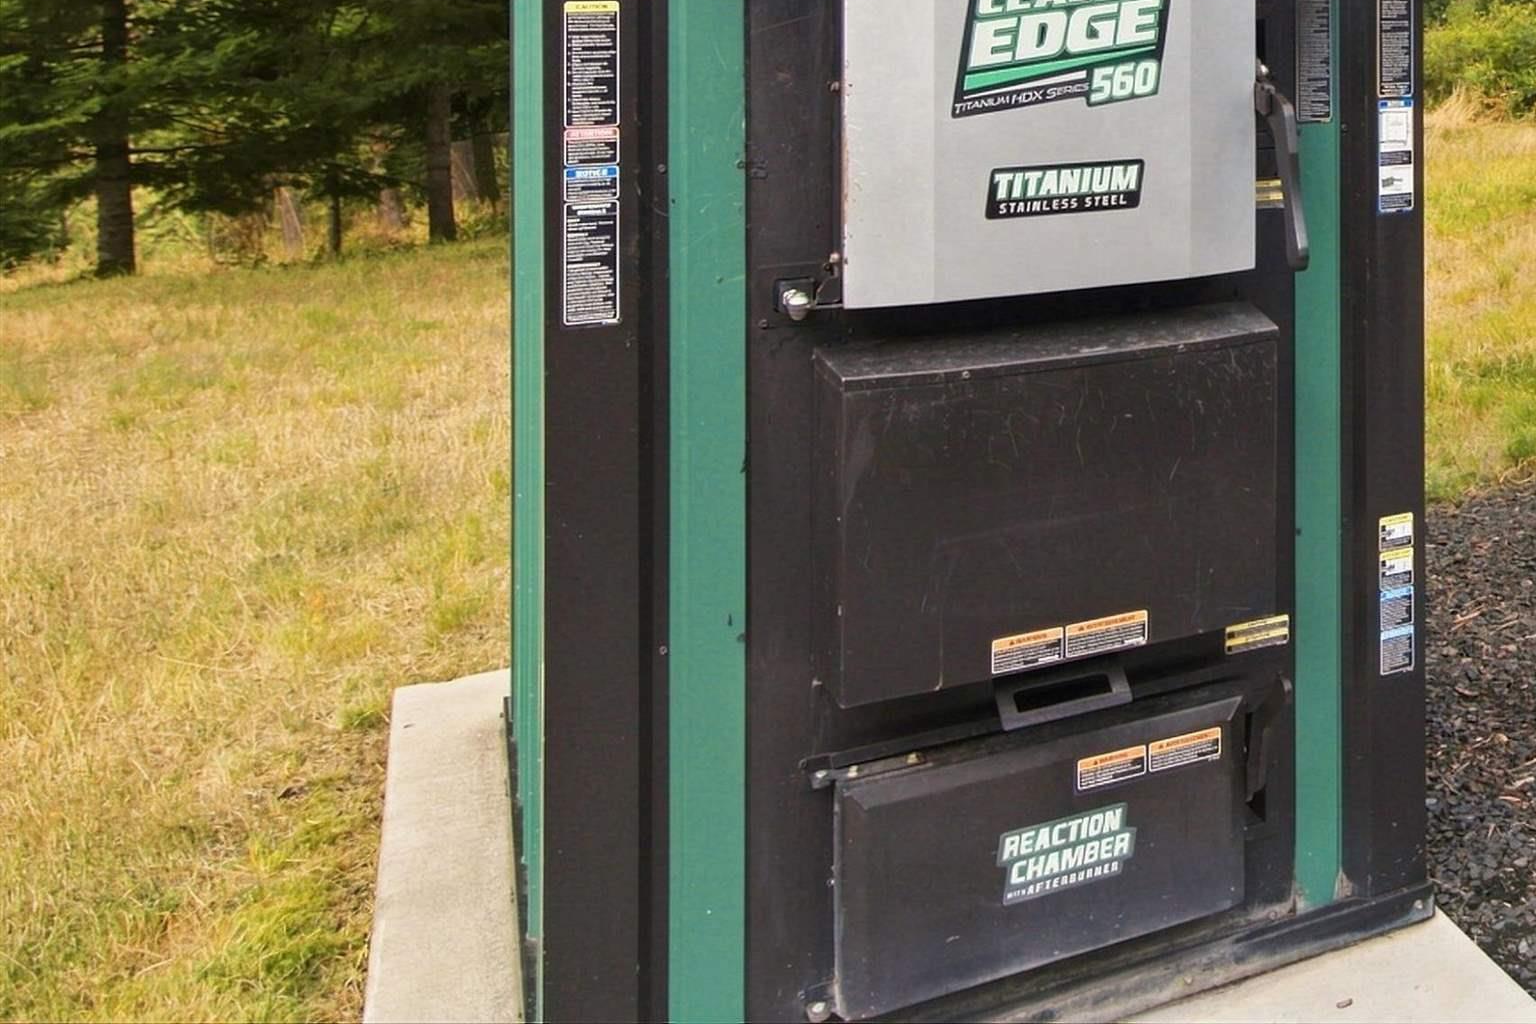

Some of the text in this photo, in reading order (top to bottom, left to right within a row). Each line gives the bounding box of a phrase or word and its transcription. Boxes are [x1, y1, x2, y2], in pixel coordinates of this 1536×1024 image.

[1090, 59, 1158, 103] 560
[955, 95, 1010, 114] TITANIUM
[1011, 88, 1044, 105] HDX
[993, 164, 1140, 201] TITANIUM
[998, 194, 1127, 215] STAINLESS STEEL
[1002, 807, 1122, 860] REACTION
[1010, 832, 1131, 884] CHAMBER
[1026, 861, 1119, 896] AFTERBURNER
